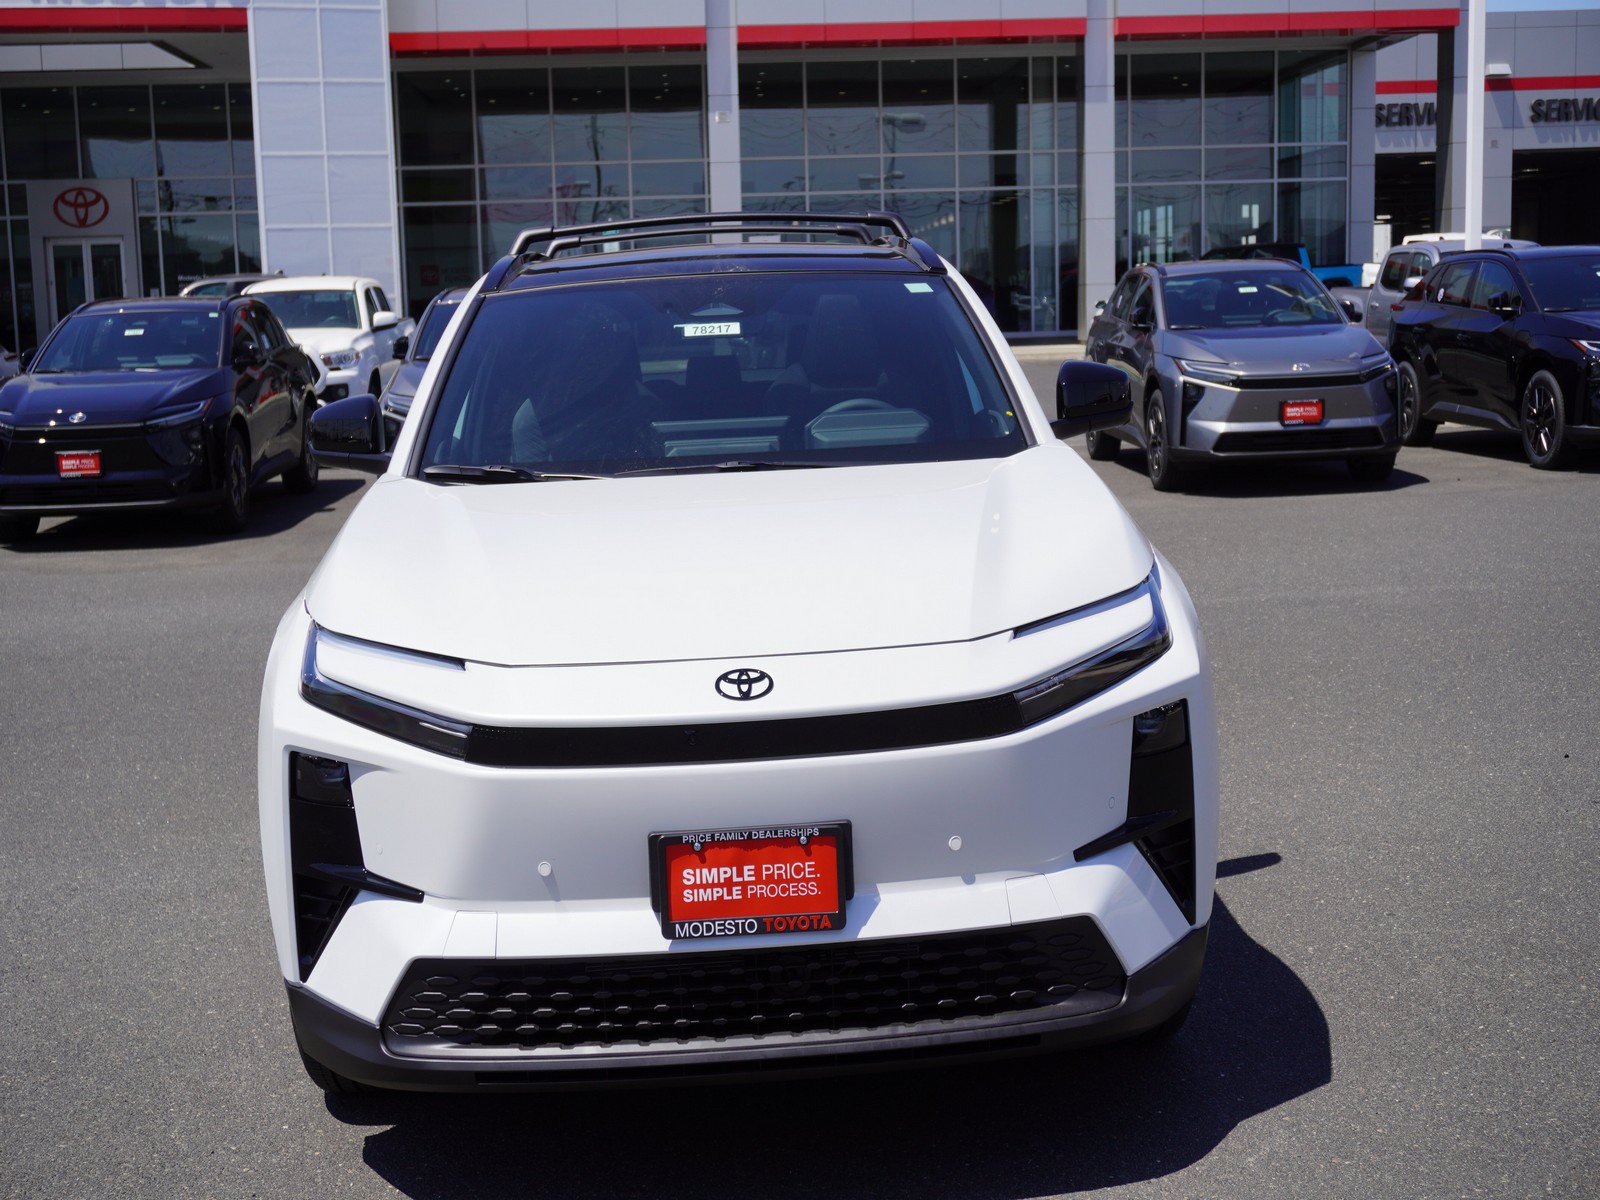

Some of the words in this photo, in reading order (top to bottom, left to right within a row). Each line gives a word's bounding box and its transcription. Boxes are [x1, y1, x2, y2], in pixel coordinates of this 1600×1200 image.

[1375, 102, 1437, 128] SERVI
[692, 324, 731, 335] 78217
[682, 833, 712, 844] PRICE
[714, 831, 749, 842] FAMILY
[752, 828, 820, 840] DEALERSHIPS
[682, 865, 756, 885] SIMPLE
[762, 861, 821, 881] PRICE.
[683, 886, 743, 903] SIMPLE
[747, 882, 822, 898] PROCESS.
[675, 918, 758, 938] MODESTO
[763, 915, 832, 932] TOYOTA
